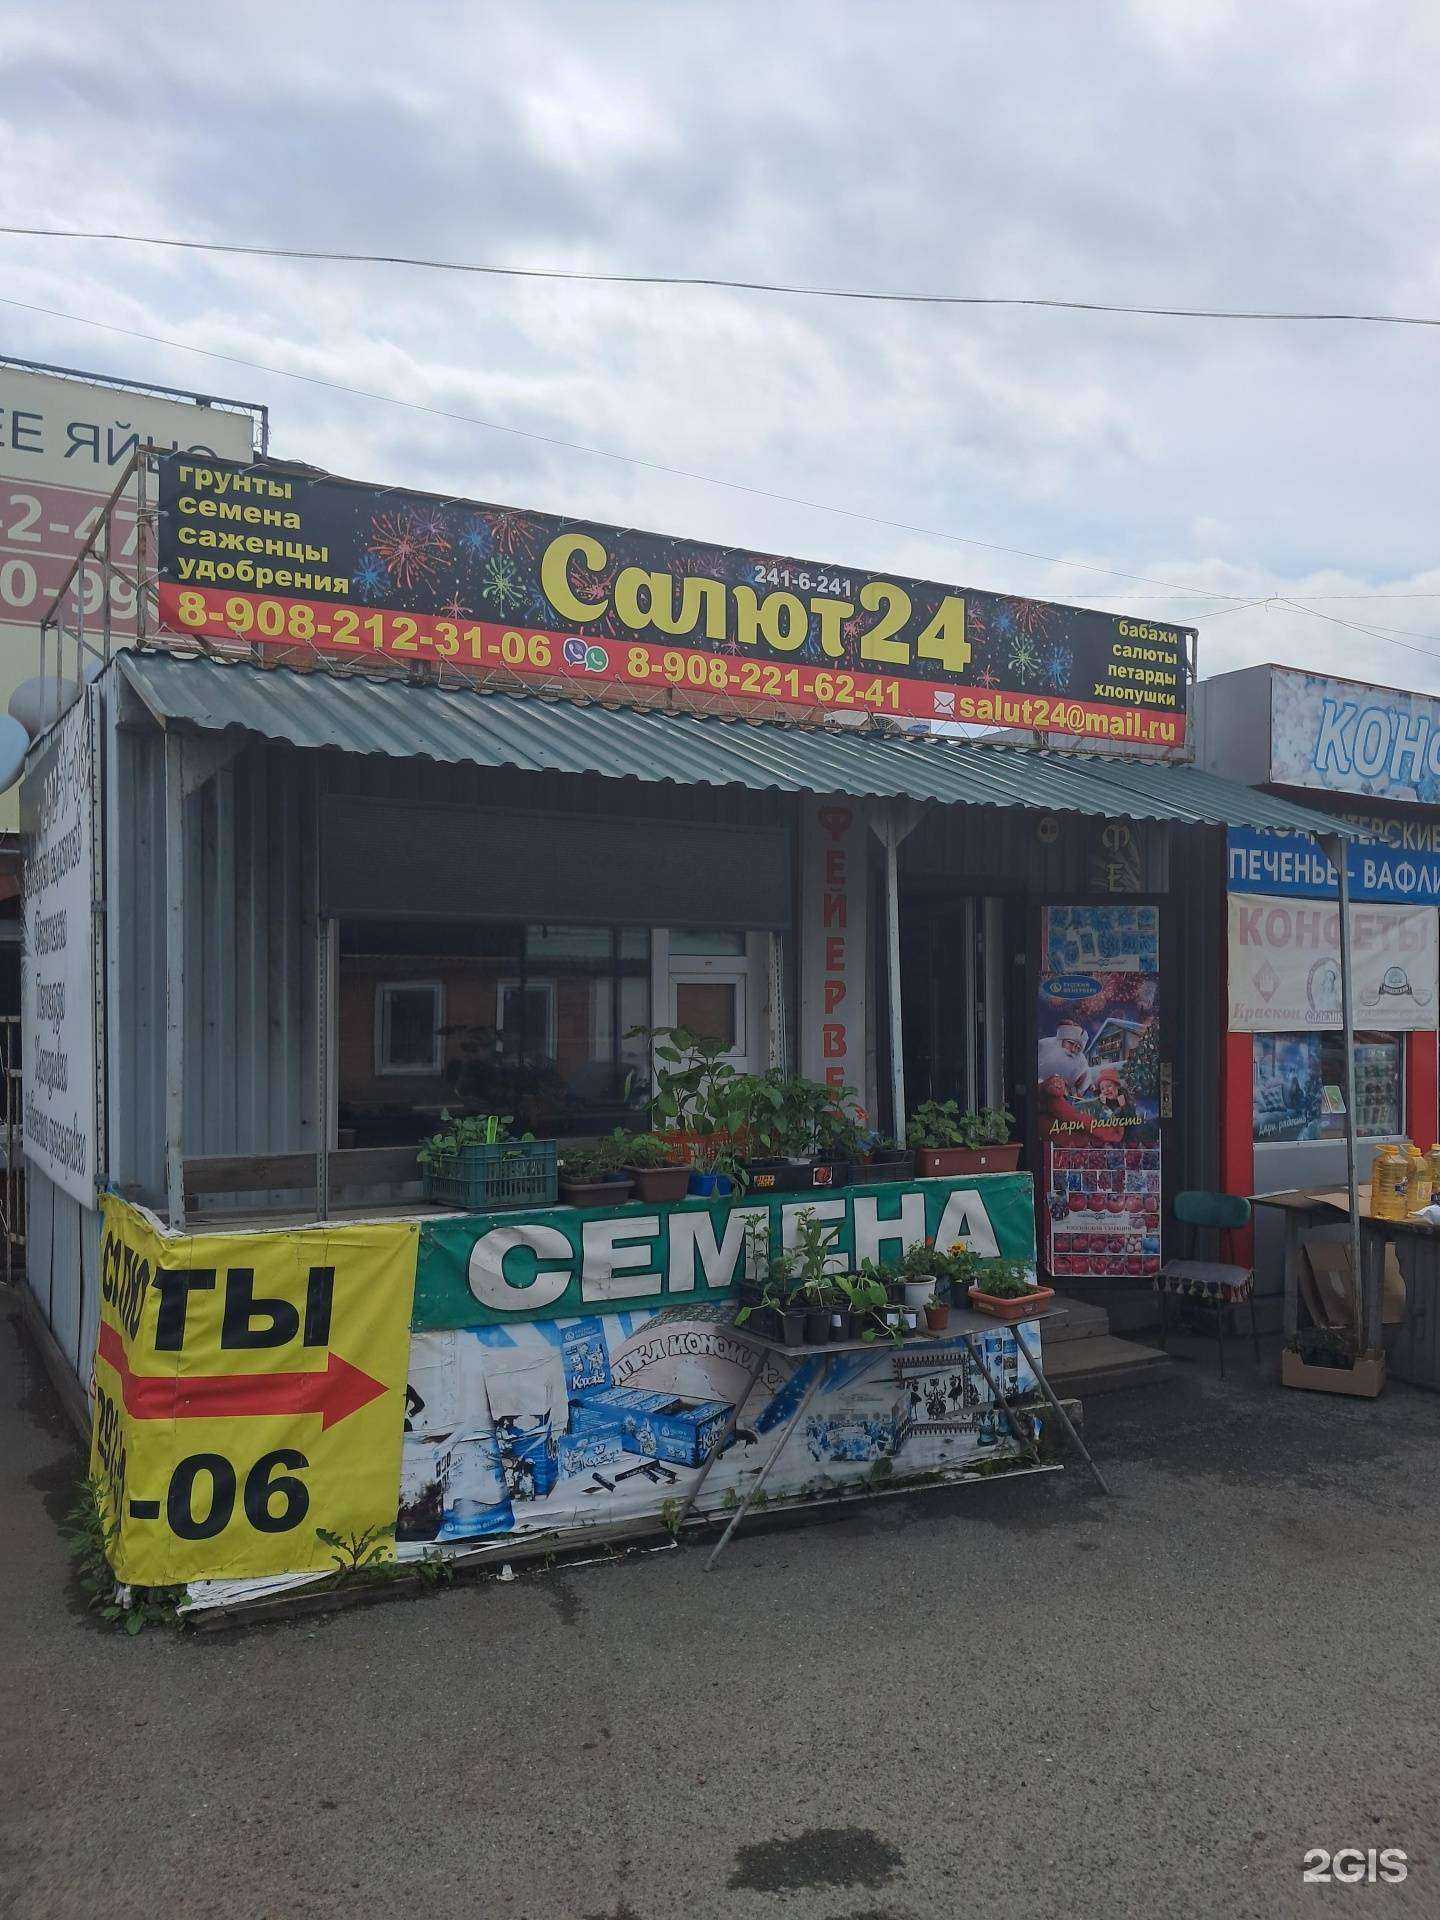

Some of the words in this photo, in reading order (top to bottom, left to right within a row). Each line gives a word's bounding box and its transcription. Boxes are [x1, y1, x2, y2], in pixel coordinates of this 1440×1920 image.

[0, 408, 44, 453] Е
[179, 465, 293, 500] грунты
[0, 494, 140, 556] 2-47
[178, 496, 302, 531] семена
[178, 525, 330, 563] саженцы
[177, 556, 349, 595] удобрения
[754, 564, 852, 597] 241-6-241
[178, 591, 552, 667] 8-908-212-31-06
[1118, 619, 1178, 645] бабахи
[1112, 643, 1178, 665] салюты
[627, 647, 901, 709] 8-908-221-62-41
[1094, 682, 1176, 707] хлопушки
[1108, 665, 1177, 687] петарды
[959, 695, 1176, 741] salut24@mail.ru
[1314, 698, 1440, 784] КОН
[1229, 848, 1340, 886] ПЕЧЕНЬЕ
[1049, 1119, 1085, 1136] Дари
[468, 1189, 1003, 1311] СЕМЕНА
